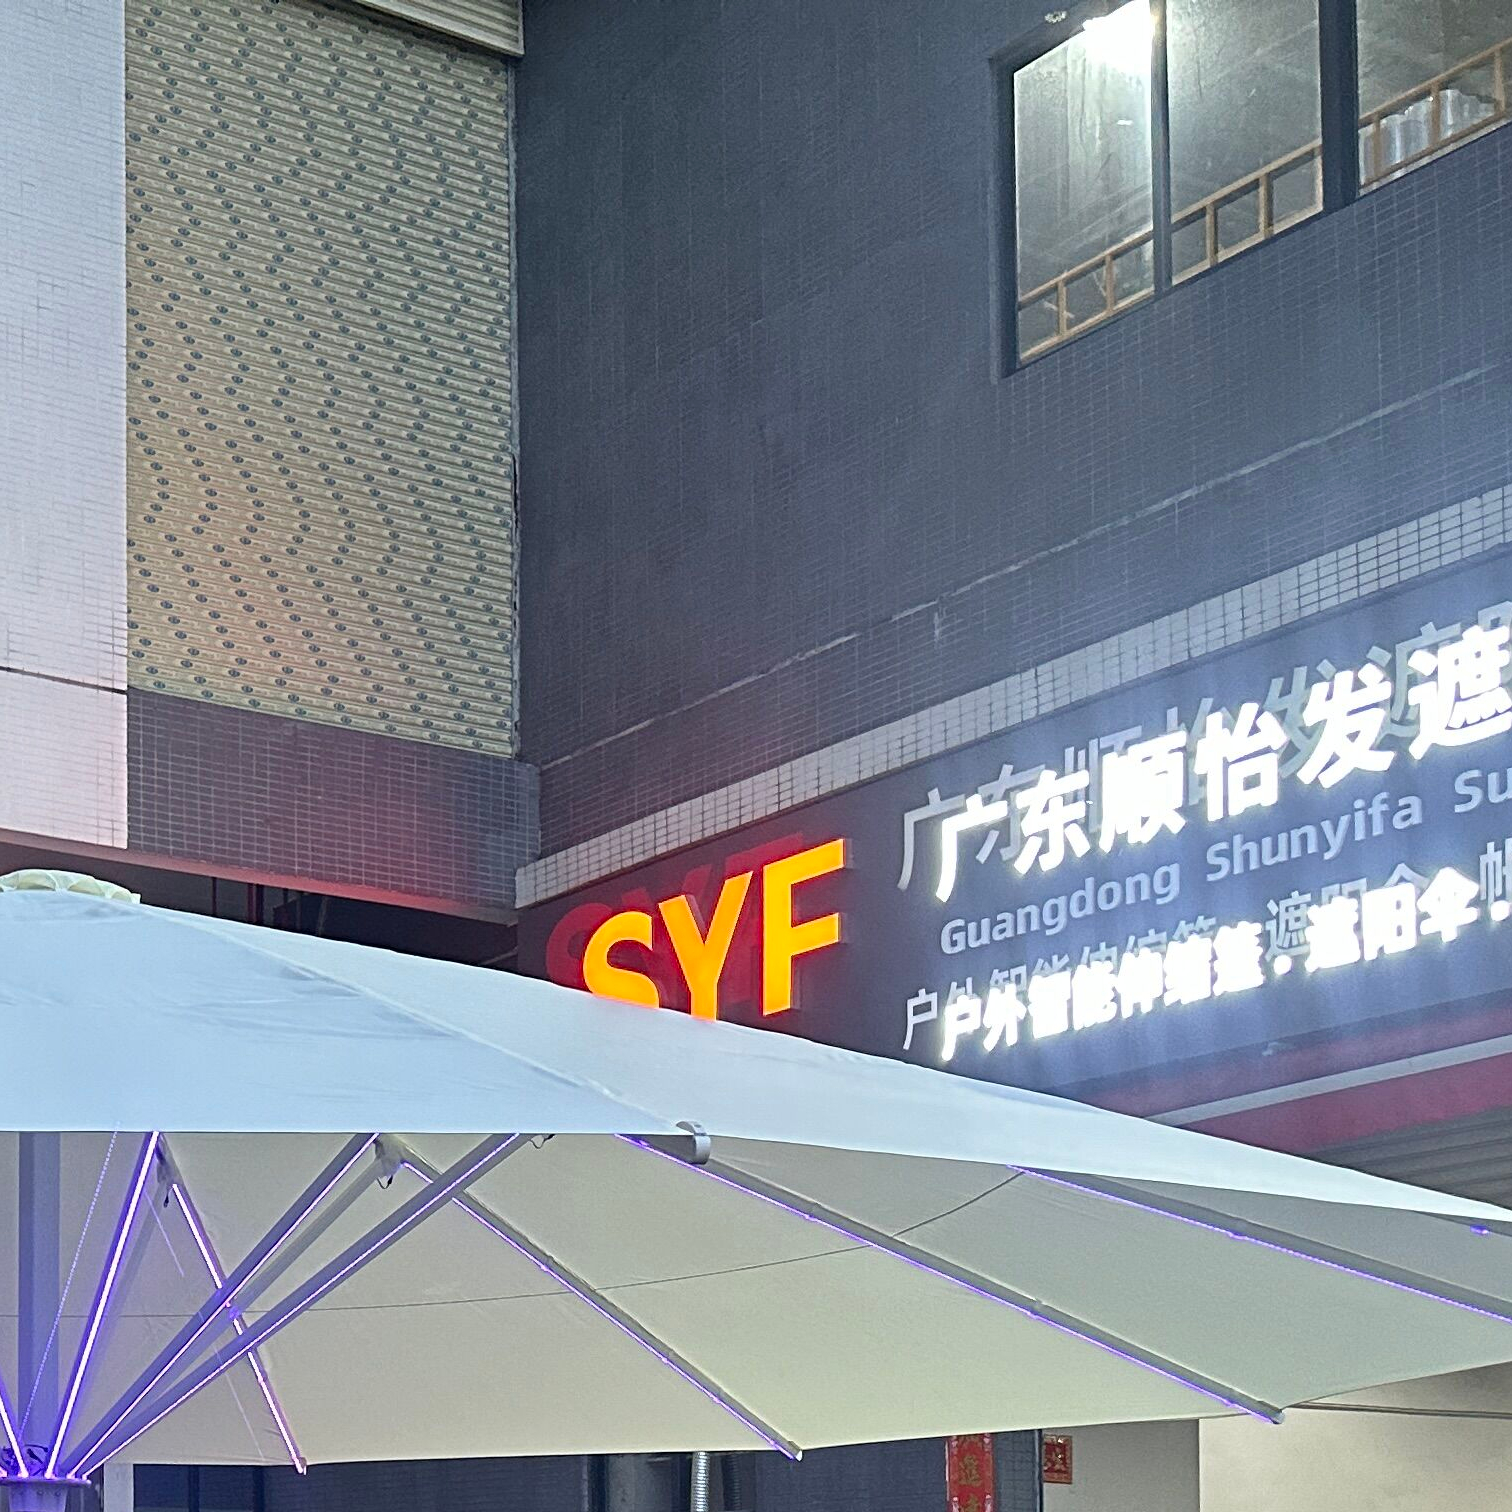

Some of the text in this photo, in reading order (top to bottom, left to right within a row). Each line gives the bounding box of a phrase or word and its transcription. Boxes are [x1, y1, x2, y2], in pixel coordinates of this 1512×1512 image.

[582, 838, 845, 1021] SYF
[940, 862, 1181, 955] Guangdong
[1206, 792, 1423, 882] Shunyifa
